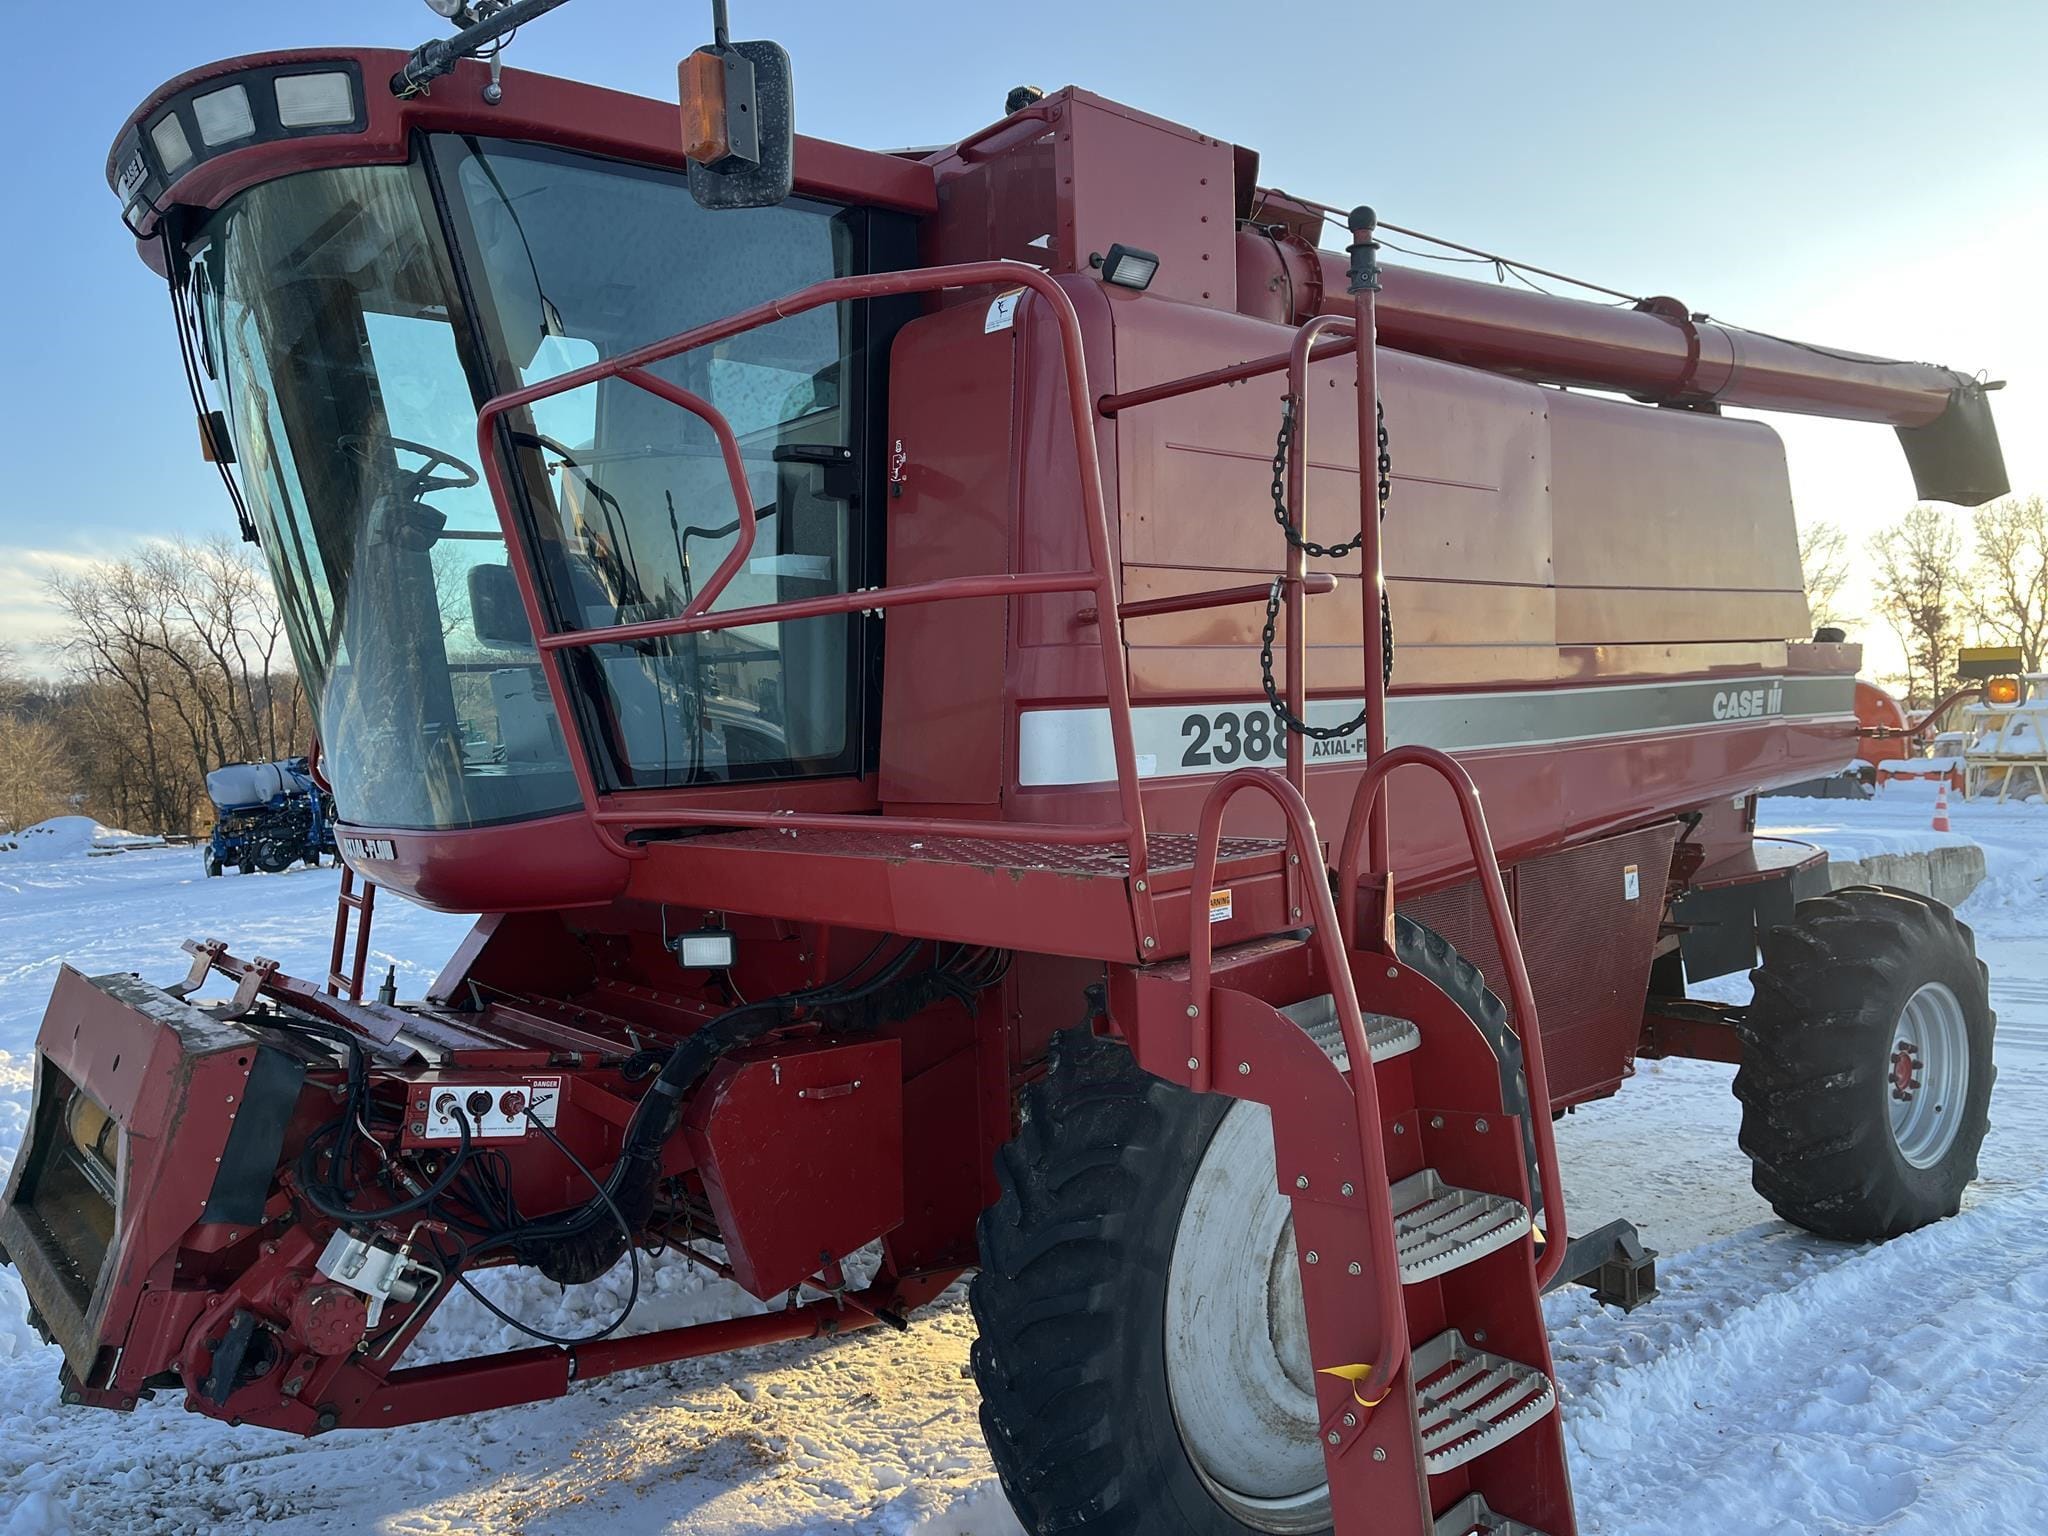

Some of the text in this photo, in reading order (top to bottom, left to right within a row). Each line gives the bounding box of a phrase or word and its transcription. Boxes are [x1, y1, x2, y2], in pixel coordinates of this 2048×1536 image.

[1712, 690, 1764, 720] CASE
[1181, 710, 1287, 767] 2388
[1312, 736, 1388, 757] AXIAL-F
[533, 1080, 558, 1088] DANGER
